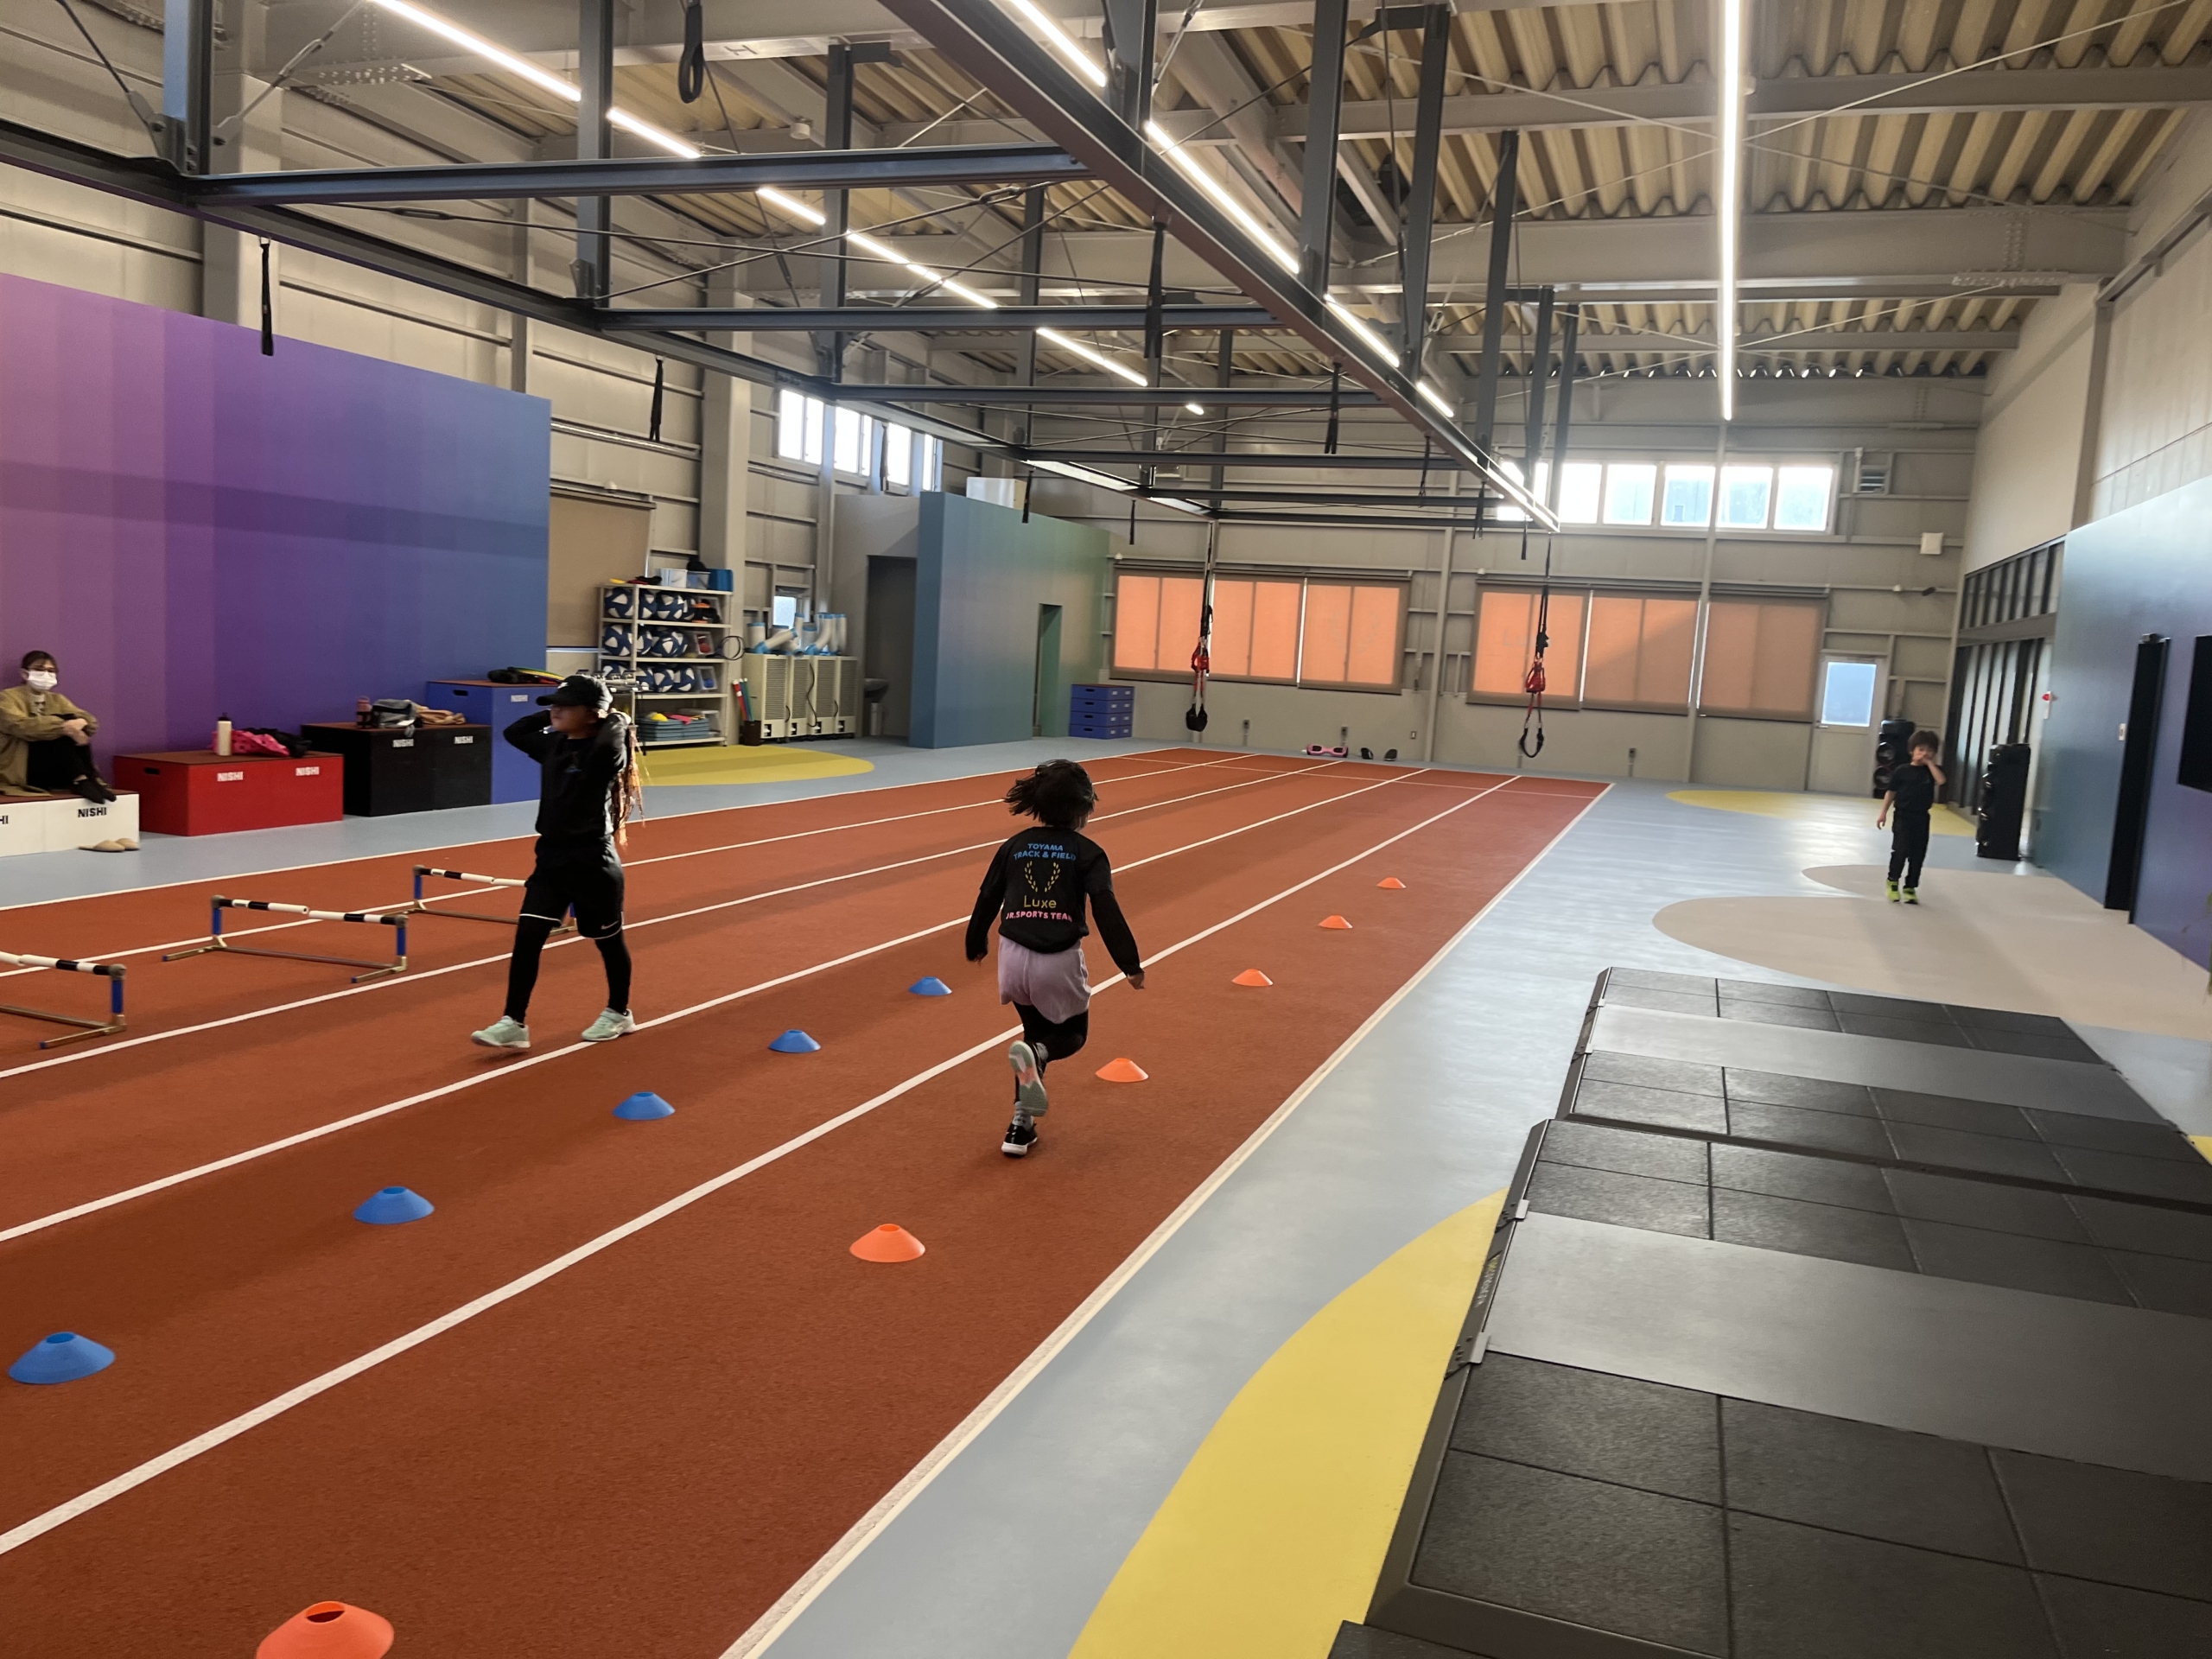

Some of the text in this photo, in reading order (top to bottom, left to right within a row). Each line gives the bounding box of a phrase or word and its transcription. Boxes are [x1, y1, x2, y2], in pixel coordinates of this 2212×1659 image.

[296, 766, 320, 776] NISHI
[217, 772, 244, 782] NISHI
[78, 807, 107, 817] NISHI
[1014, 850, 1039, 860] TRACK
[1052, 852, 1077, 861] FIELD
[1024, 895, 1057, 908] Luxe
